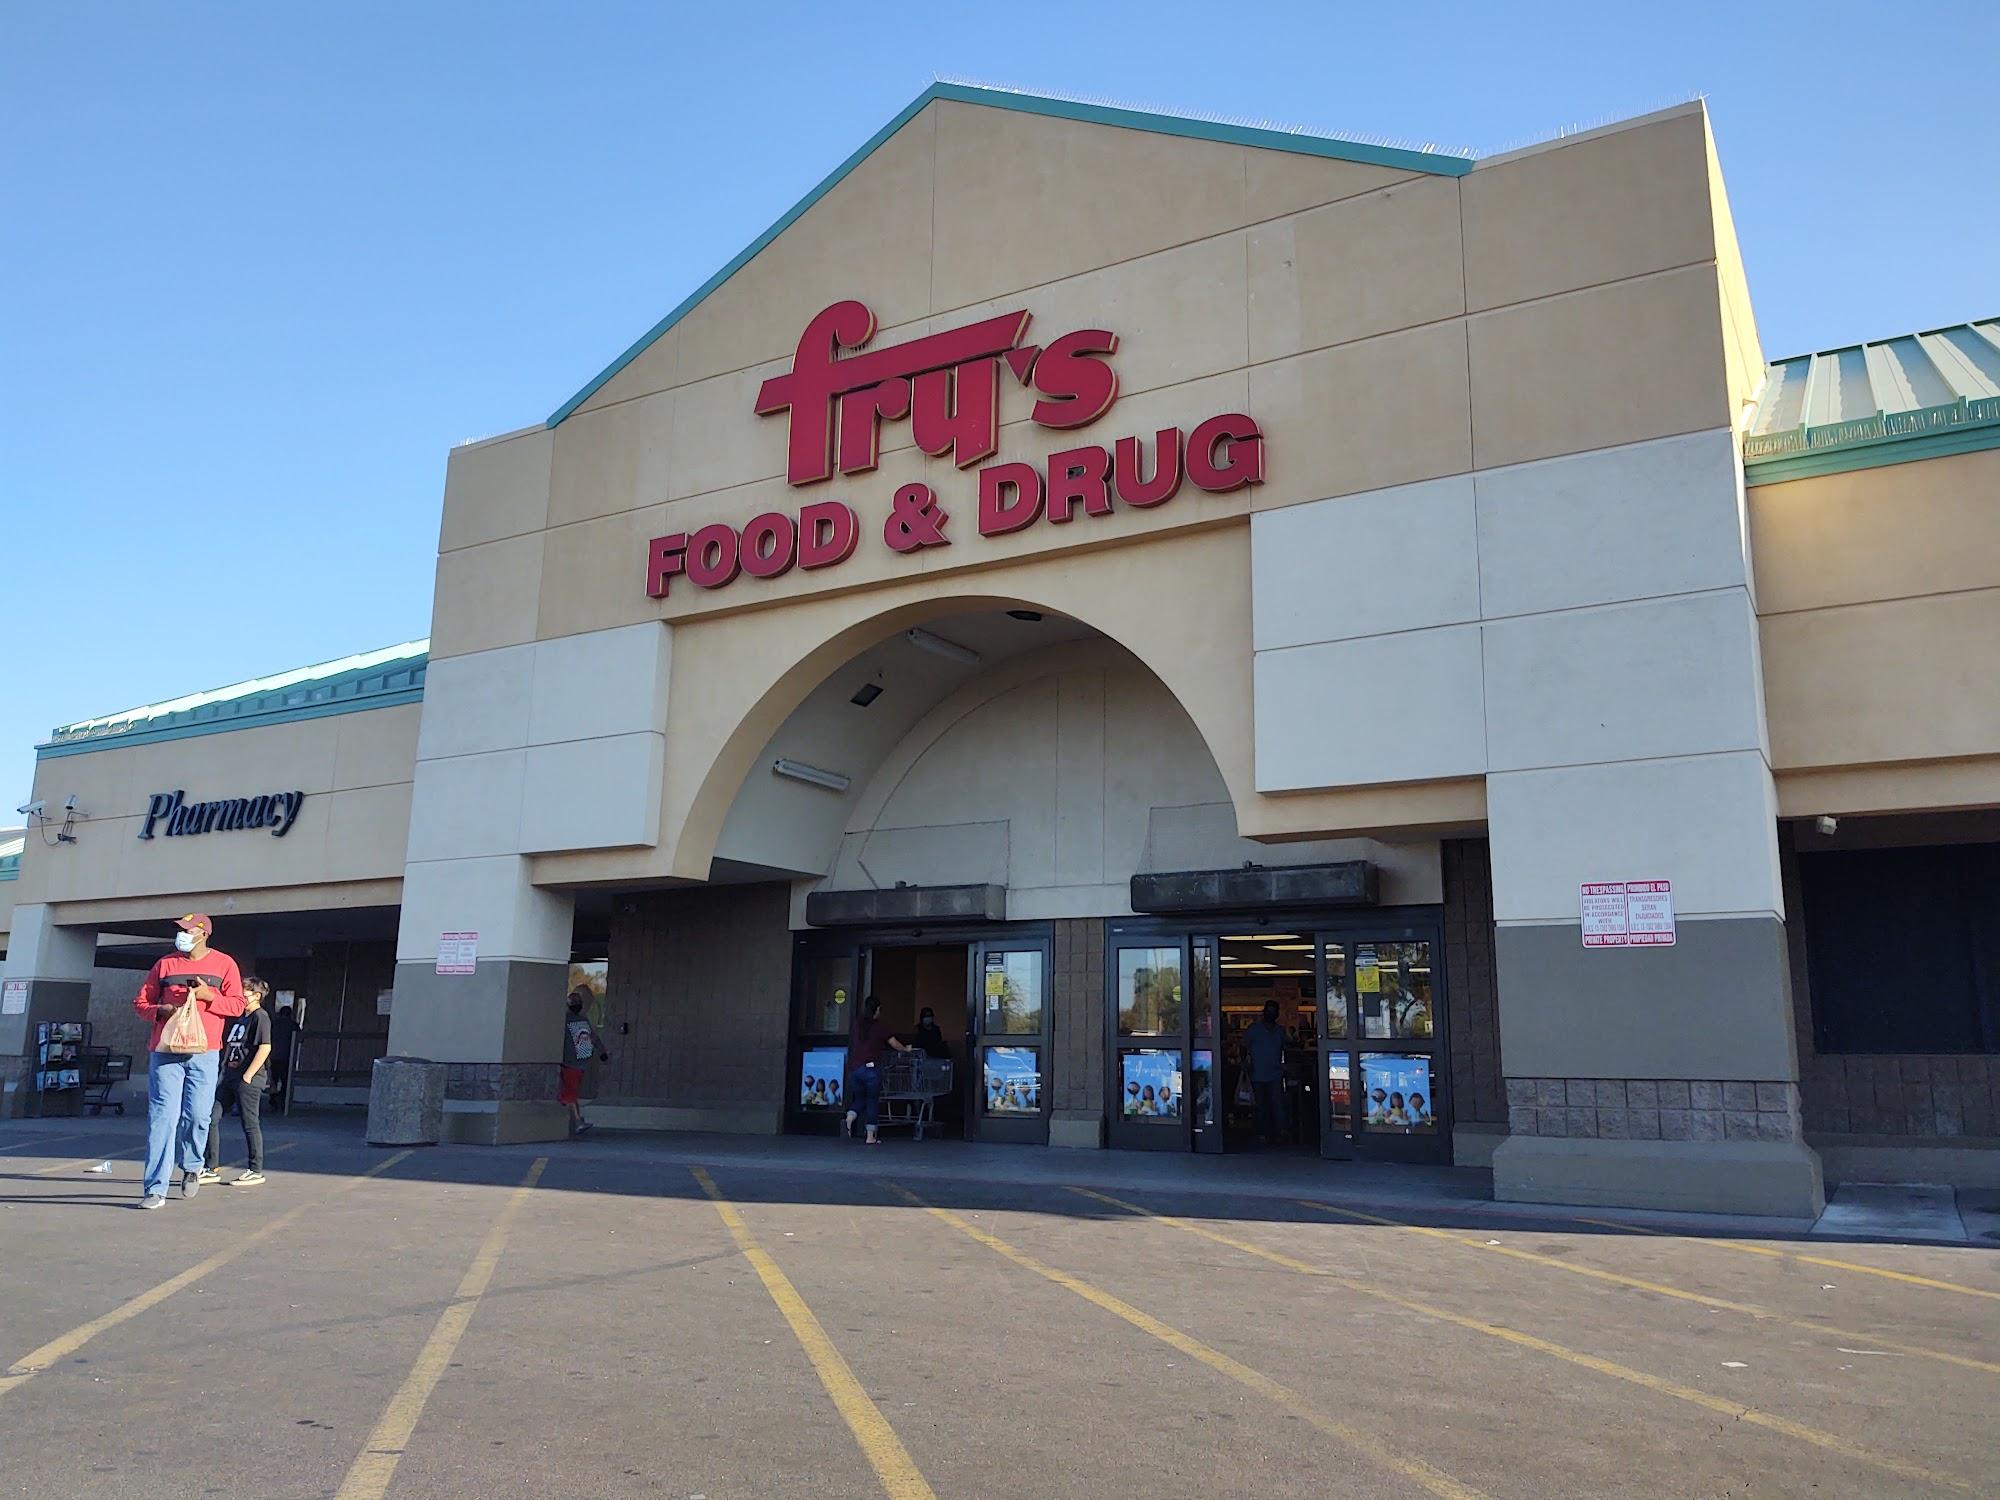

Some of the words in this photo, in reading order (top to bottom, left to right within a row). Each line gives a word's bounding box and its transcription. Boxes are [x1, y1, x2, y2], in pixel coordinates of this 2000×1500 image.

[753, 300, 1121, 487] fry's
[645, 501, 859, 599] FOOD
[883, 482, 952, 553] &
[977, 413, 1266, 538] DRUG
[137, 790, 304, 839] Pharmacy
